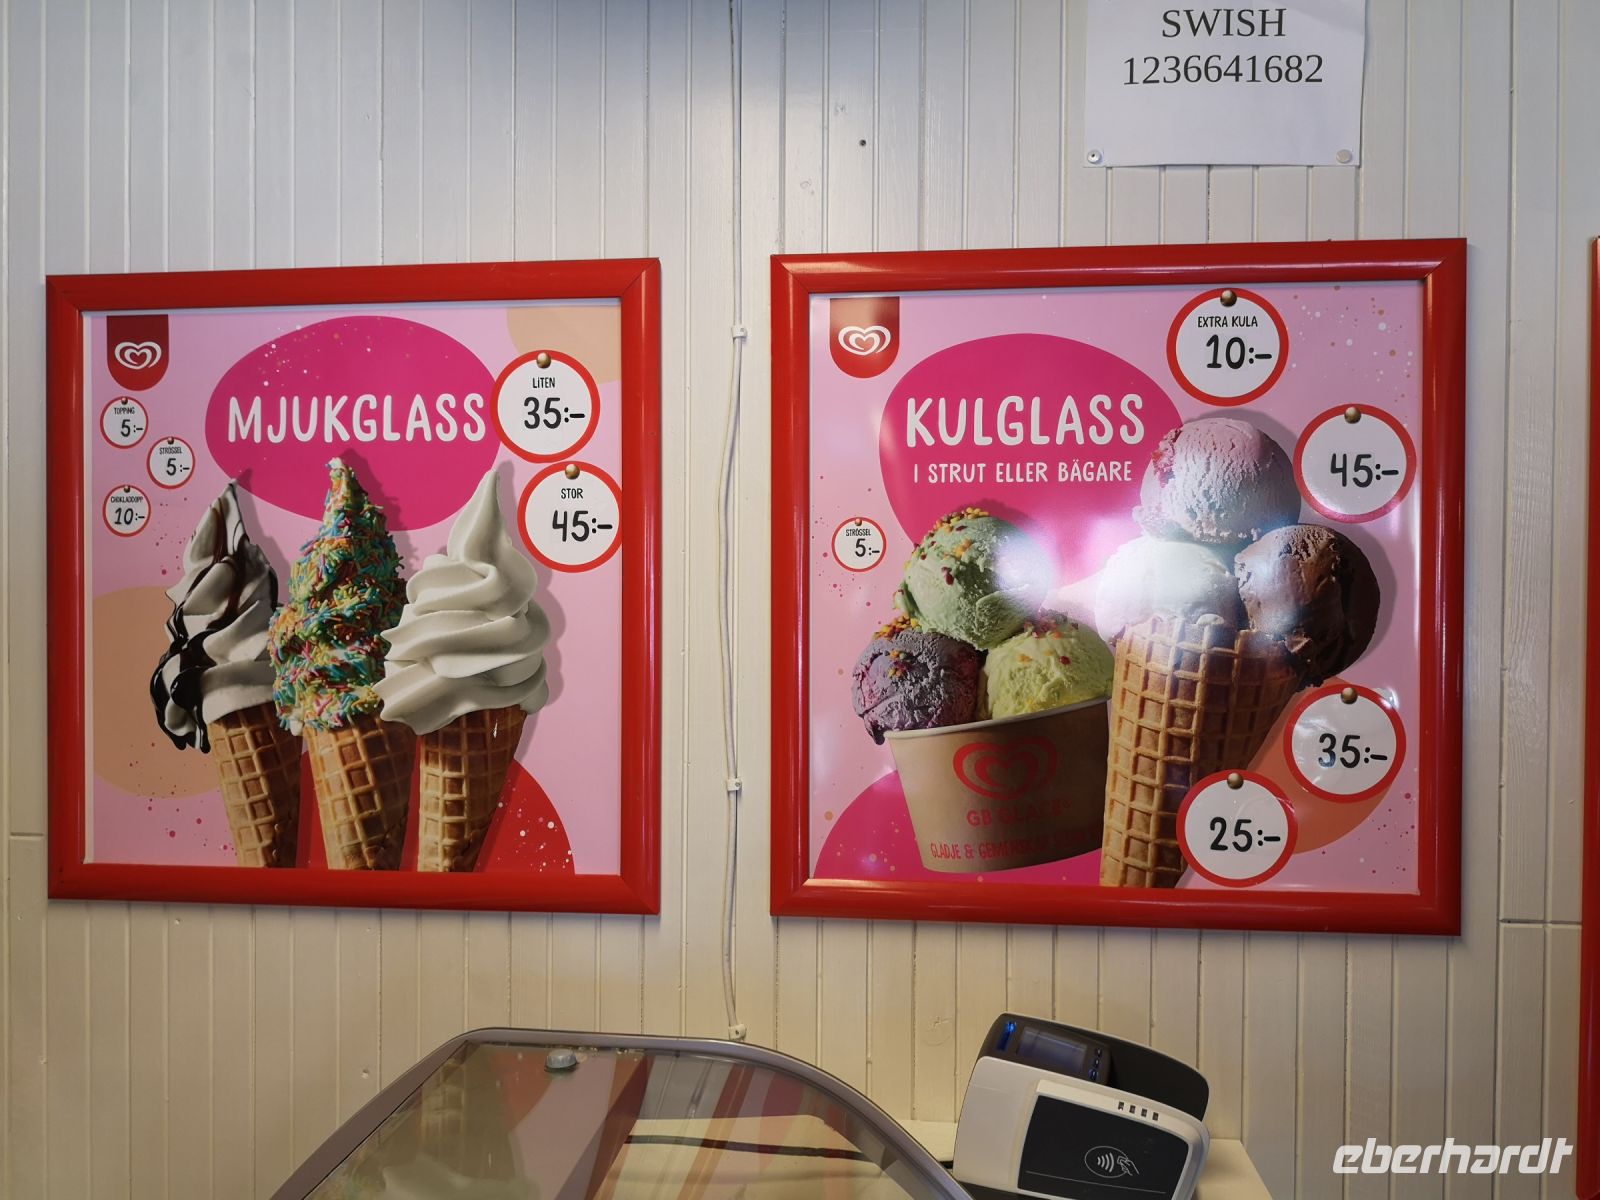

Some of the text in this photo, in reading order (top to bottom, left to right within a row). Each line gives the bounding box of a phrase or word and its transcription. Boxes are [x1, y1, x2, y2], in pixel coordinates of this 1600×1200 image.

[1162, 8, 1286, 37] SWISH
[1122, 54, 1324, 85] 1236641682
[1197, 316, 1258, 328] EXTRA KULA
[227, 393, 486, 443] MJUKGLASS
[906, 393, 1145, 448] KULGLASS
[913, 459, 1132, 484] I STRUT ELLER BÄGARE
[560, 488, 584, 500] STOR
[966, 809, 993, 828] GB
